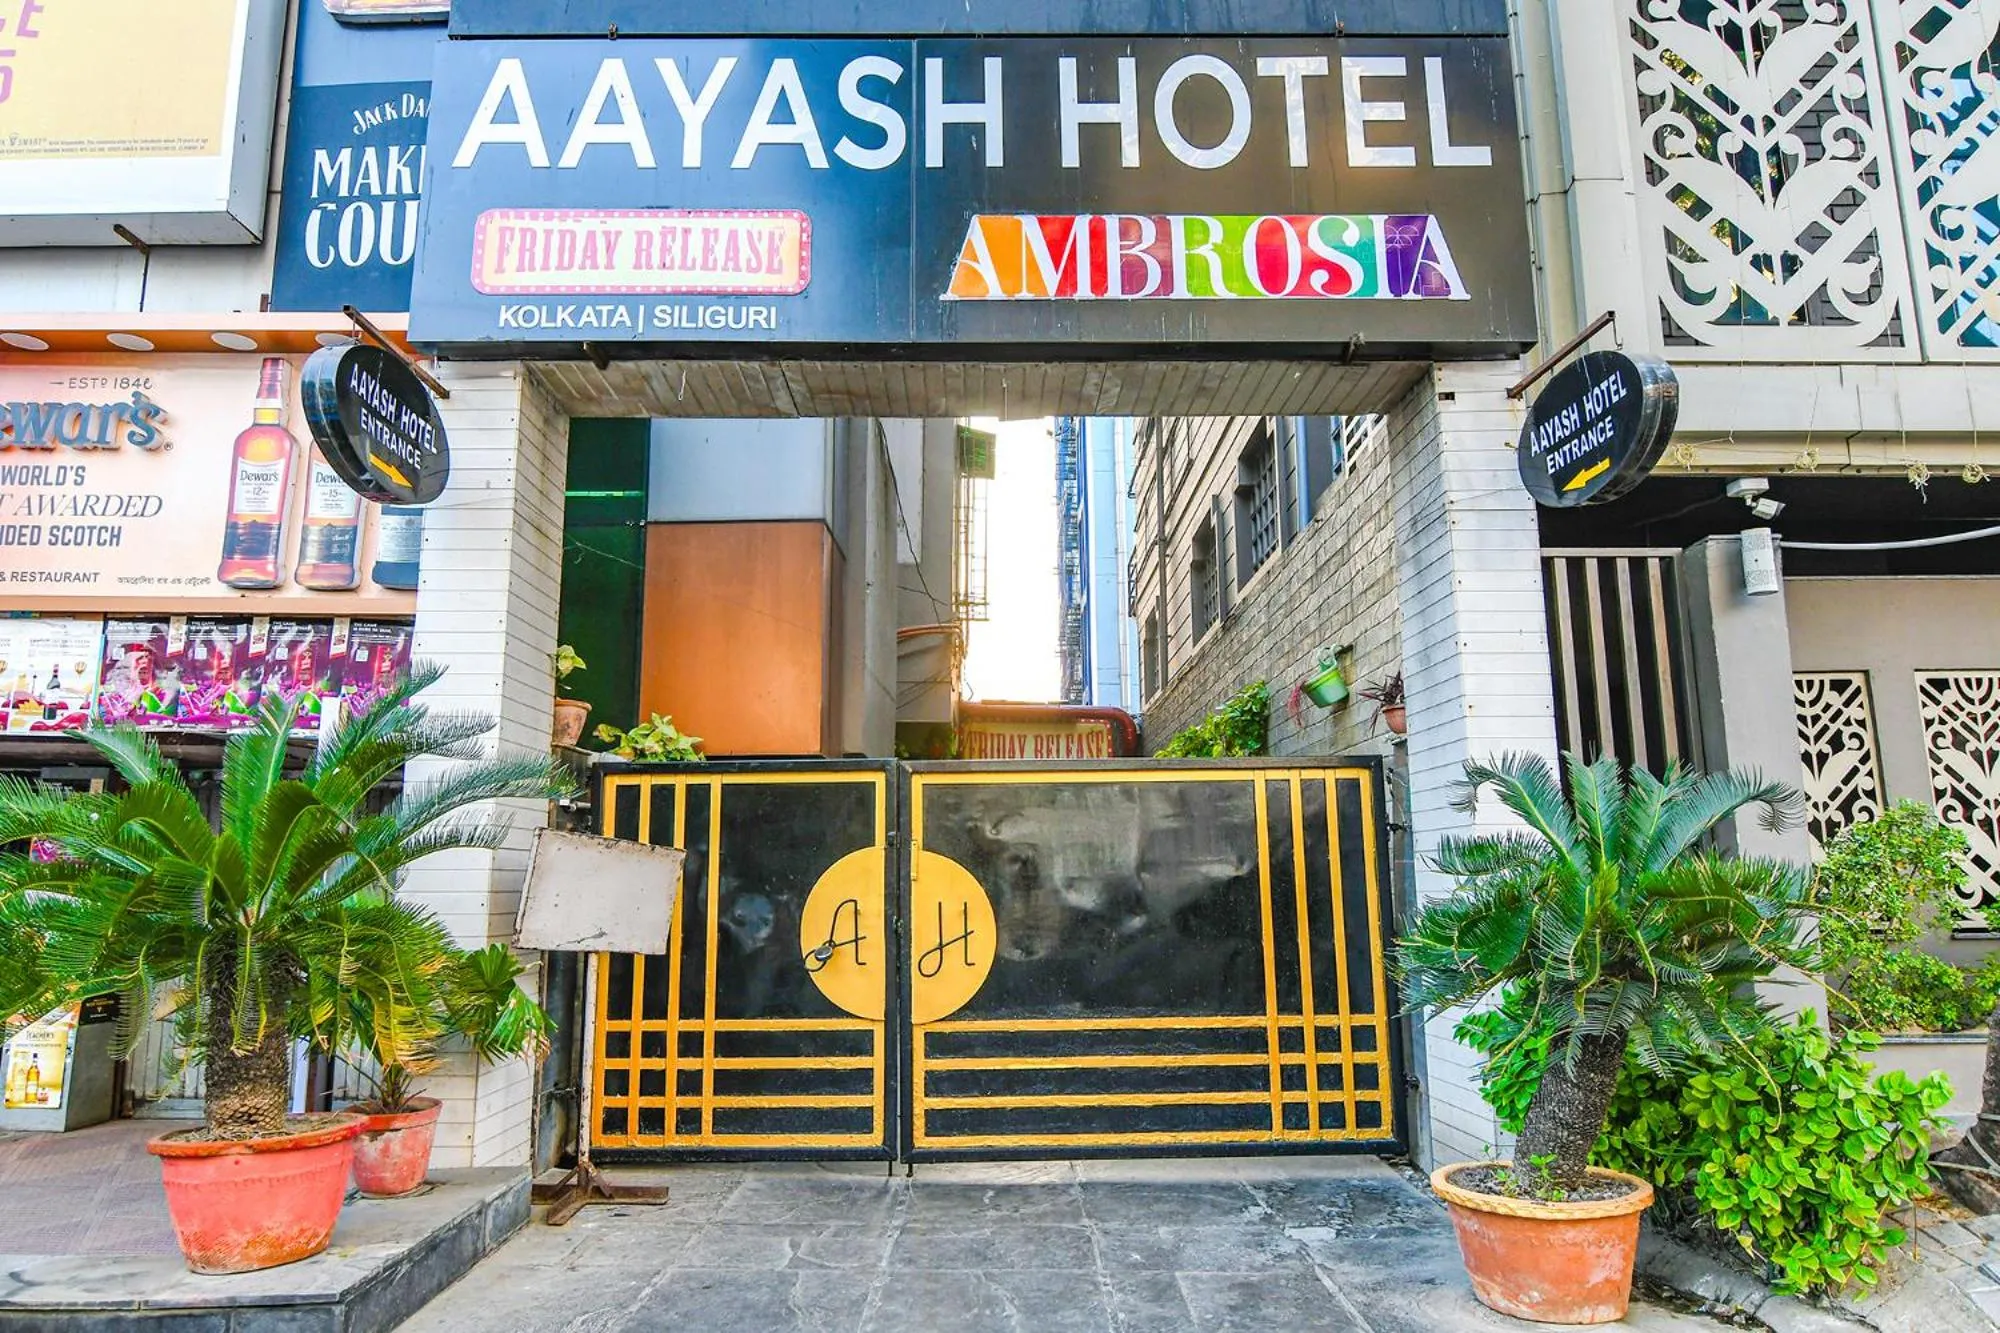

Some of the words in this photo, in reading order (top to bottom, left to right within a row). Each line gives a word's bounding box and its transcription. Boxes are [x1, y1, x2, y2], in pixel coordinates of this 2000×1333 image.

[402, 92, 431, 119] DA
[452, 56, 1004, 169] AAYASH
[1058, 54, 1493, 169] HOTEL
[494, 226, 622, 274] FRIDAY
[633, 226, 784, 275] RELEASE
[939, 214, 1471, 301] AMBROSIA
[499, 305, 631, 328] KOLKATA
[653, 305, 777, 329] SILIGURI
[350, 362, 397, 424] AAYASH
[400, 405, 437, 455] HOTEL
[1530, 402, 1581, 458] AAYASH
[1583, 370, 1628, 422] HOTEL
[360, 407, 421, 470] ENTRANCE
[1546, 415, 1615, 475] ENTRANCE
[1, 465, 86, 486] WORLD'S
[13, 494, 163, 518] AWARDED
[48, 525, 122, 547] SCOTCH
[10, 571, 101, 583] RESTAURANT
